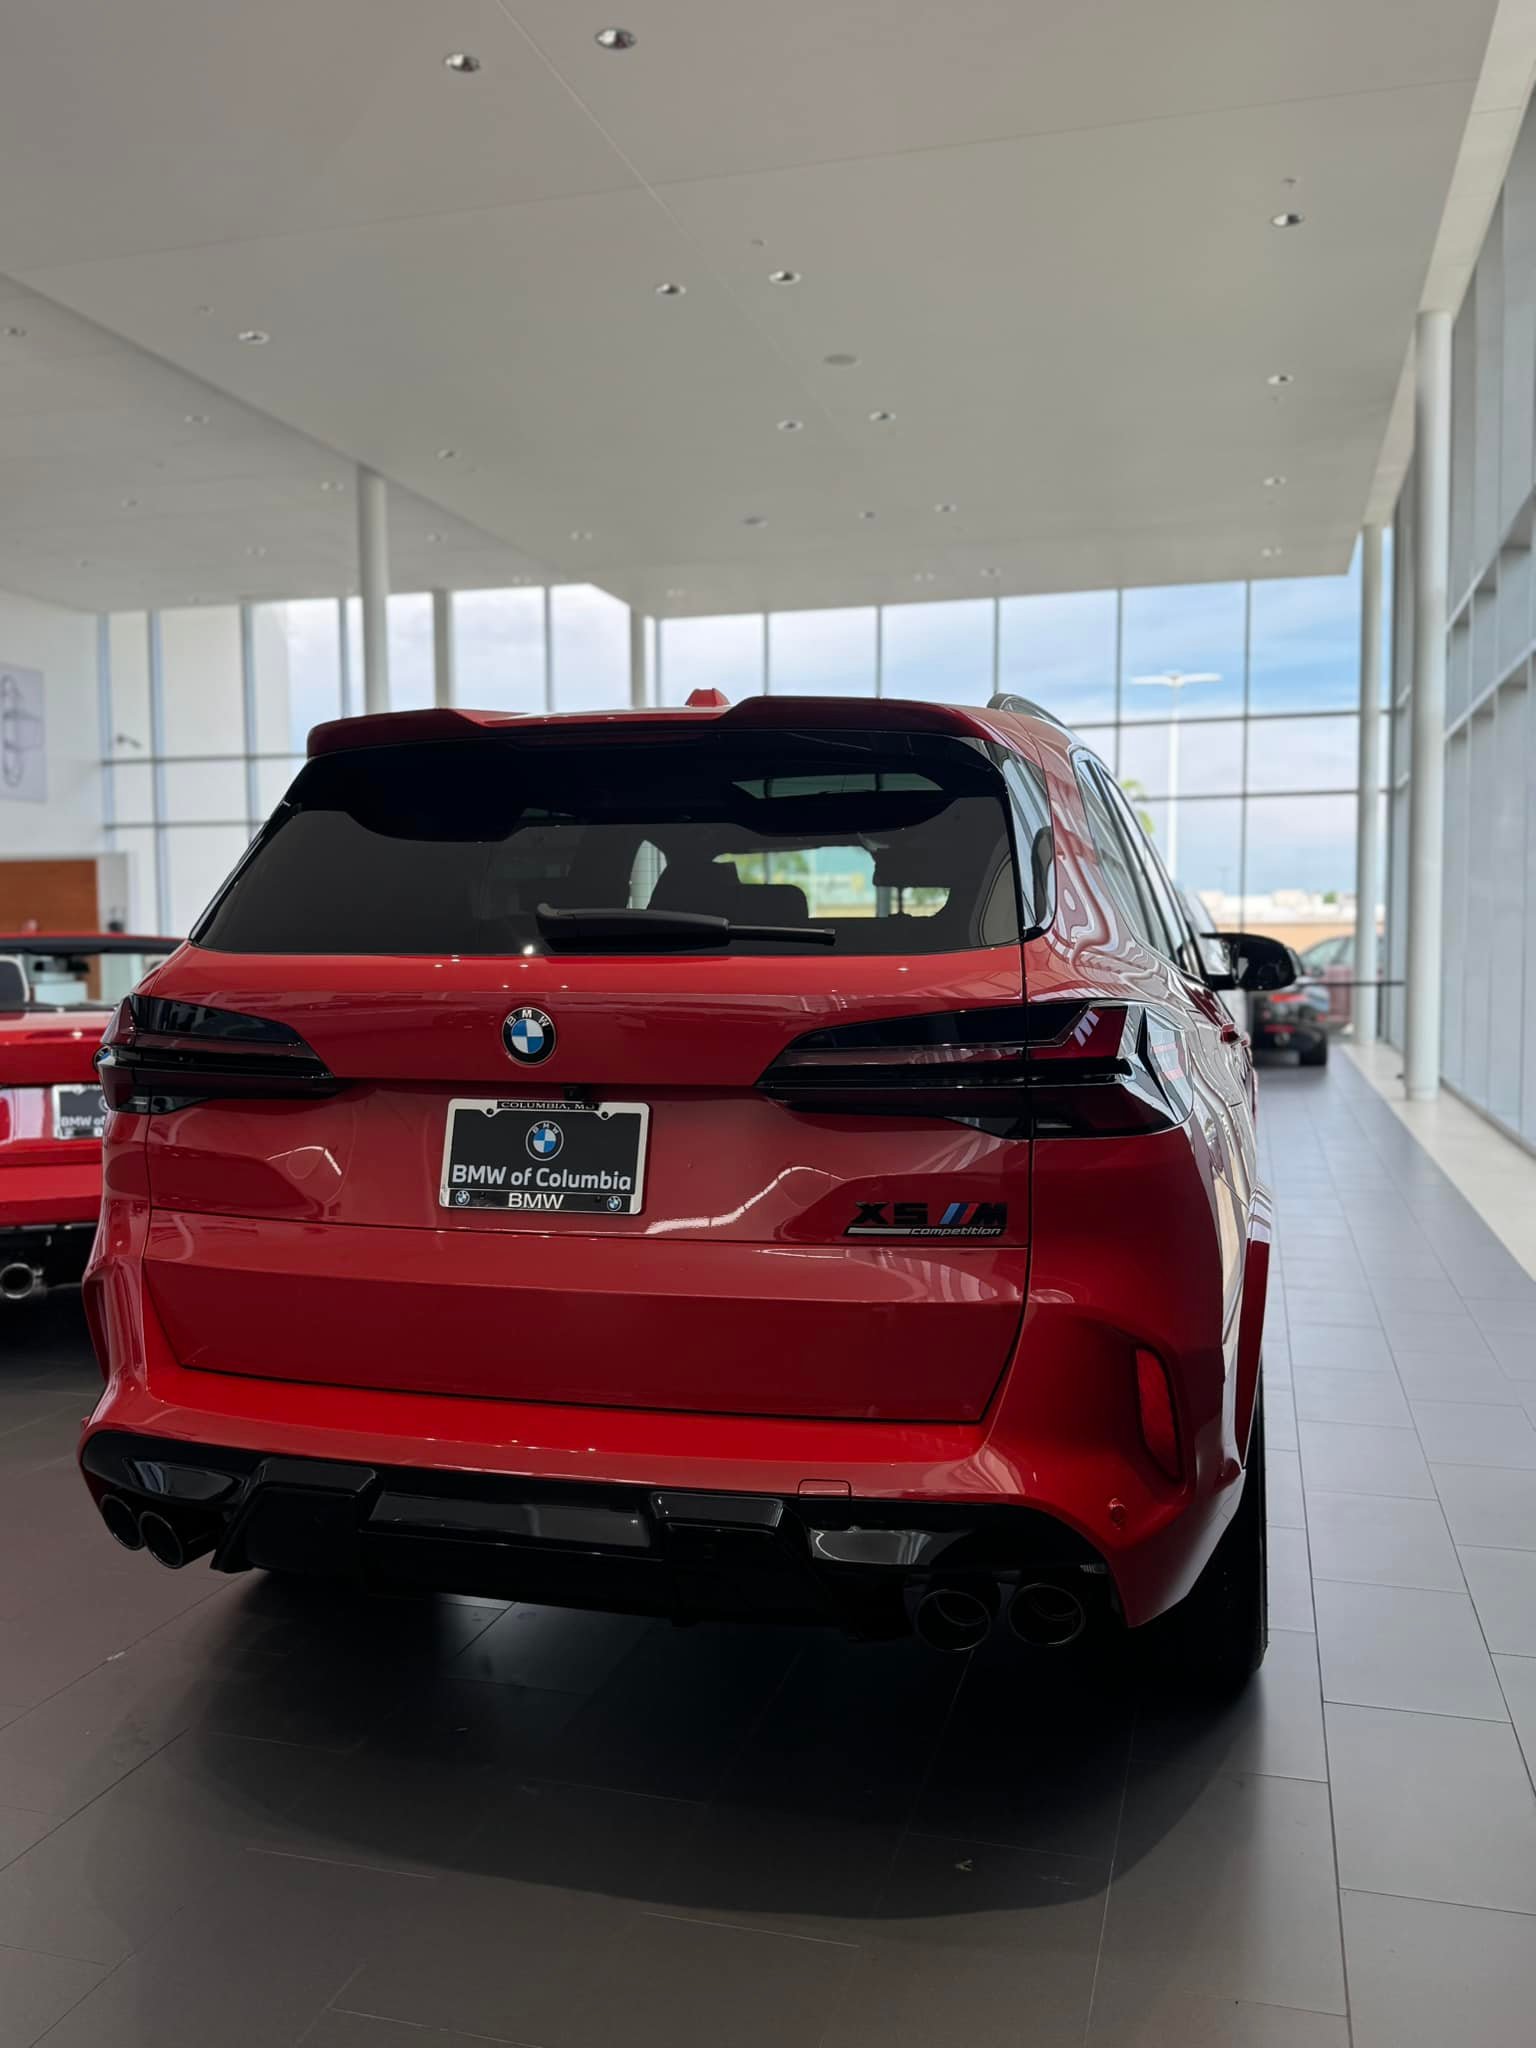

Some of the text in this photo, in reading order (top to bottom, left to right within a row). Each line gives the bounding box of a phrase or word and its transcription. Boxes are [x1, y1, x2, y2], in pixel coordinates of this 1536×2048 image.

[506, 1009, 550, 1027] BMW
[60, 1116, 92, 1127] BMW
[532, 1122, 559, 1134] BMW
[452, 1164, 632, 1190] BMW of Columbia
[508, 1193, 564, 1209] BMW
[852, 1202, 928, 1225] X5
[910, 1226, 1001, 1237] competition
